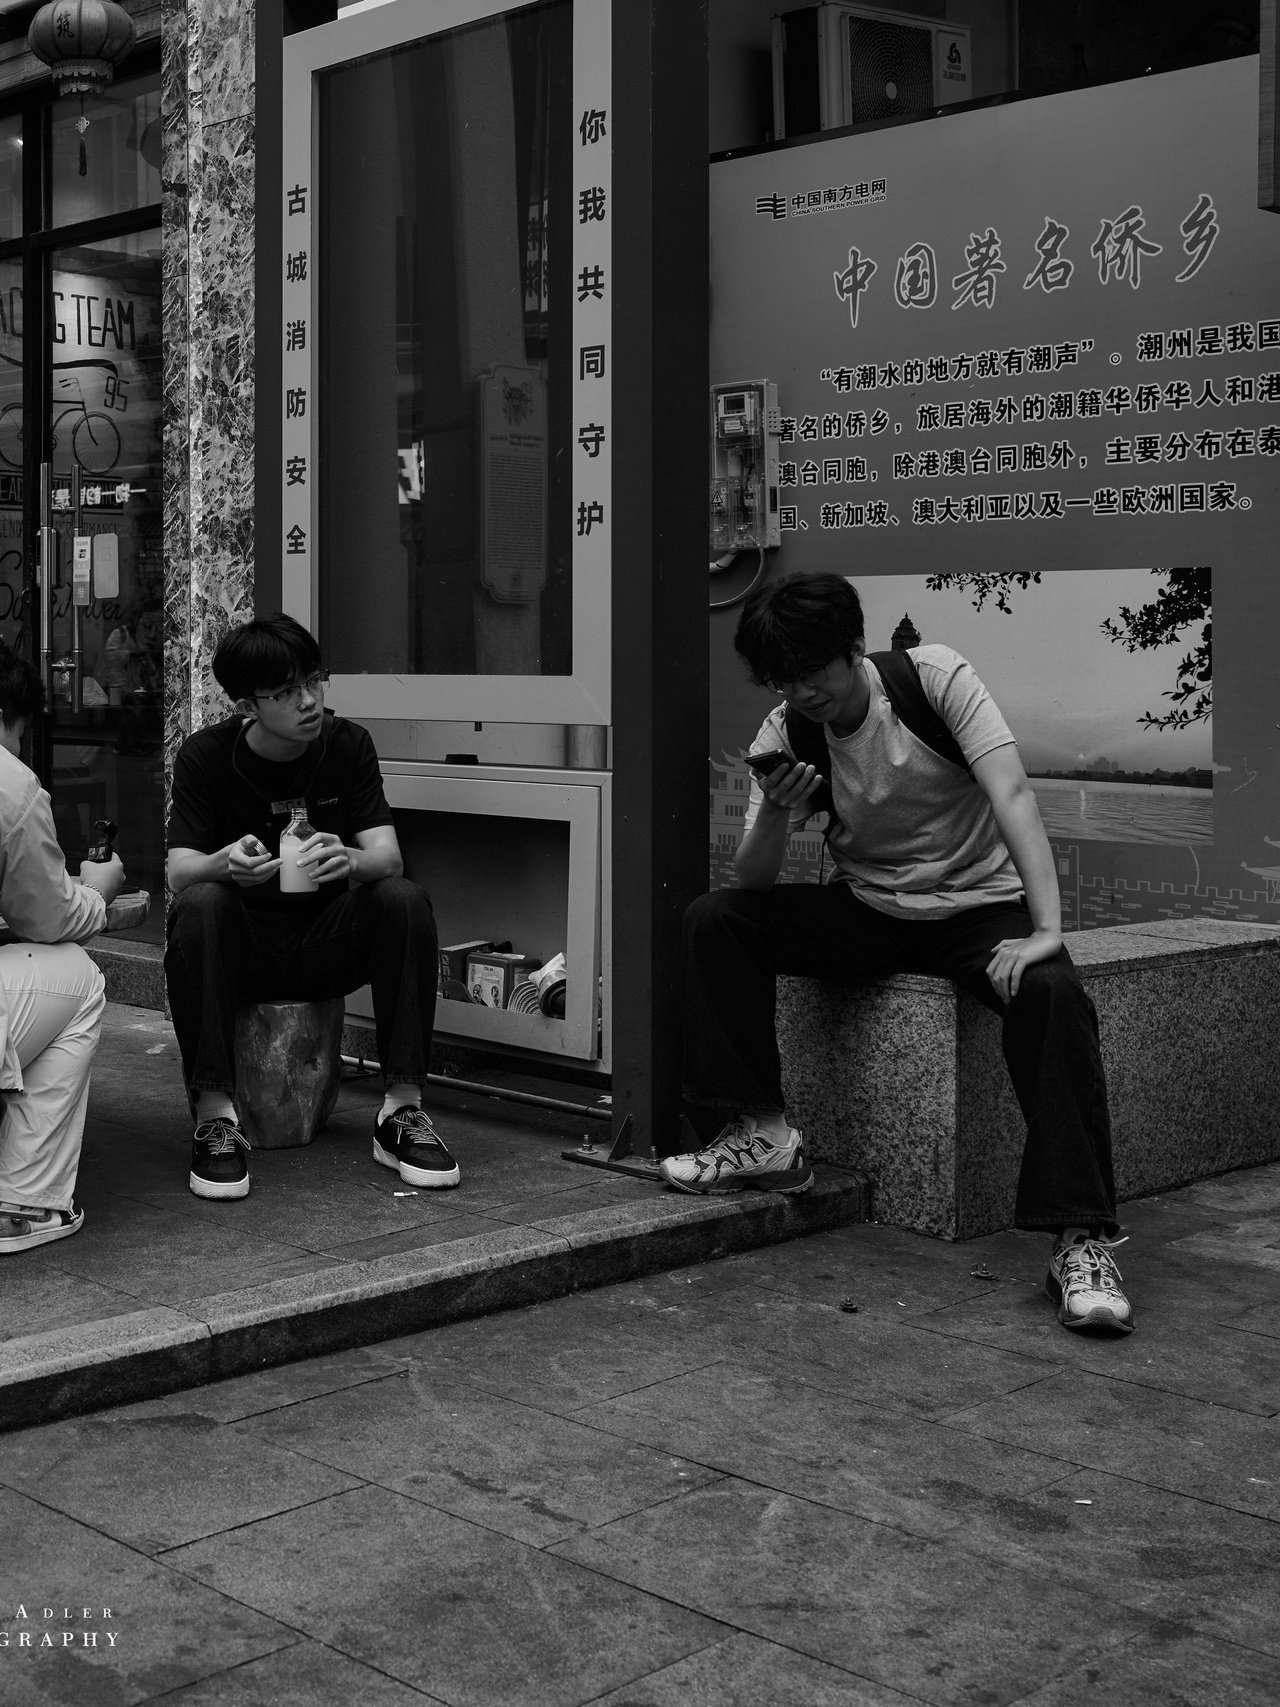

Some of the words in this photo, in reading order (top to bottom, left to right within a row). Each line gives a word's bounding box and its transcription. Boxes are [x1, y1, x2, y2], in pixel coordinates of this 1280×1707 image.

[792, 179, 886, 209] 中国南方电网
[812, 203, 845, 213] SOUTHERN
[846, 199, 869, 207] POWER
[871, 195, 886, 203] GRID
[834, 194, 1221, 328] 中国著名侨乡
[71, 293, 135, 350] TEAM
[576, 108, 608, 537] 你我共同守护
[285, 184, 309, 556] 古城消防安全
